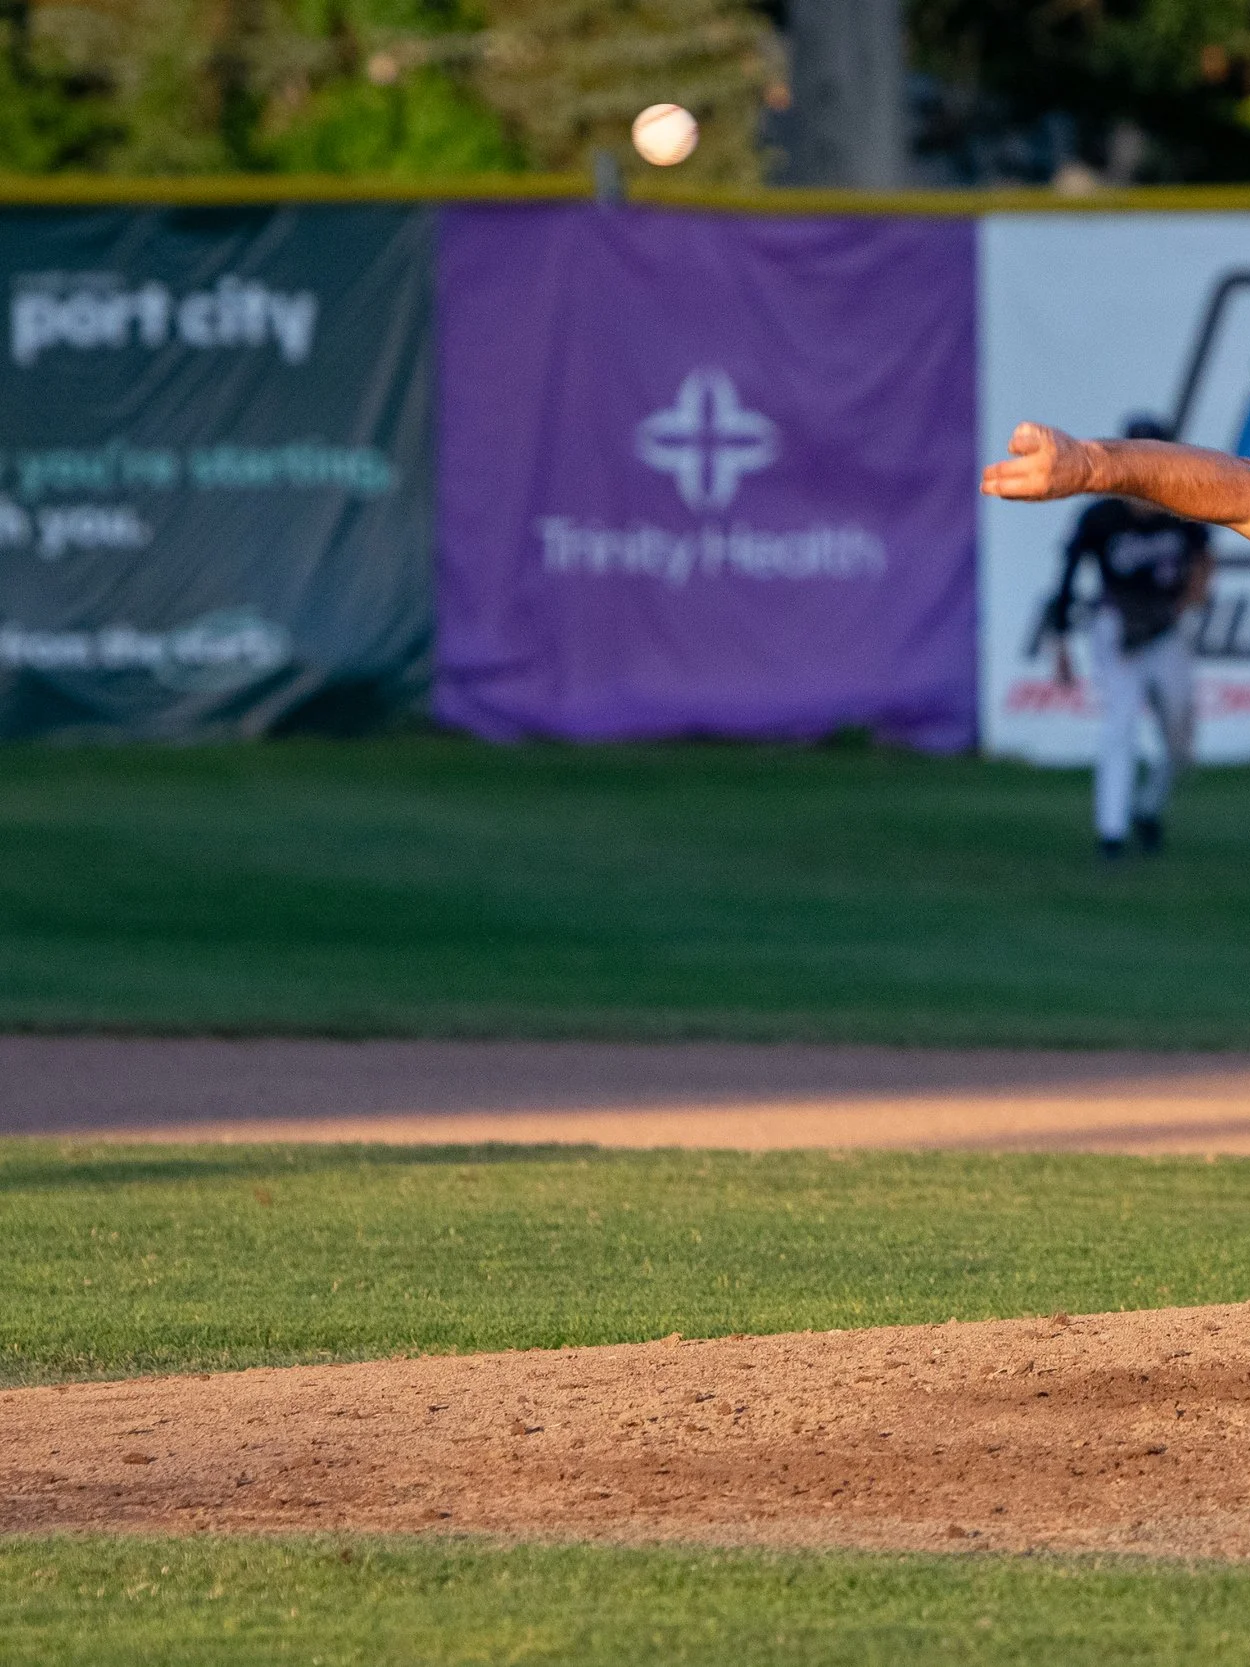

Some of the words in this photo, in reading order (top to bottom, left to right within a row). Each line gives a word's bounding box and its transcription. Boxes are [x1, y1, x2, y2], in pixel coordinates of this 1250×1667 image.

[12, 282, 169, 362] port
[180, 277, 316, 362] city
[538, 518, 692, 586] Trinity
[703, 522, 888, 580] Health
